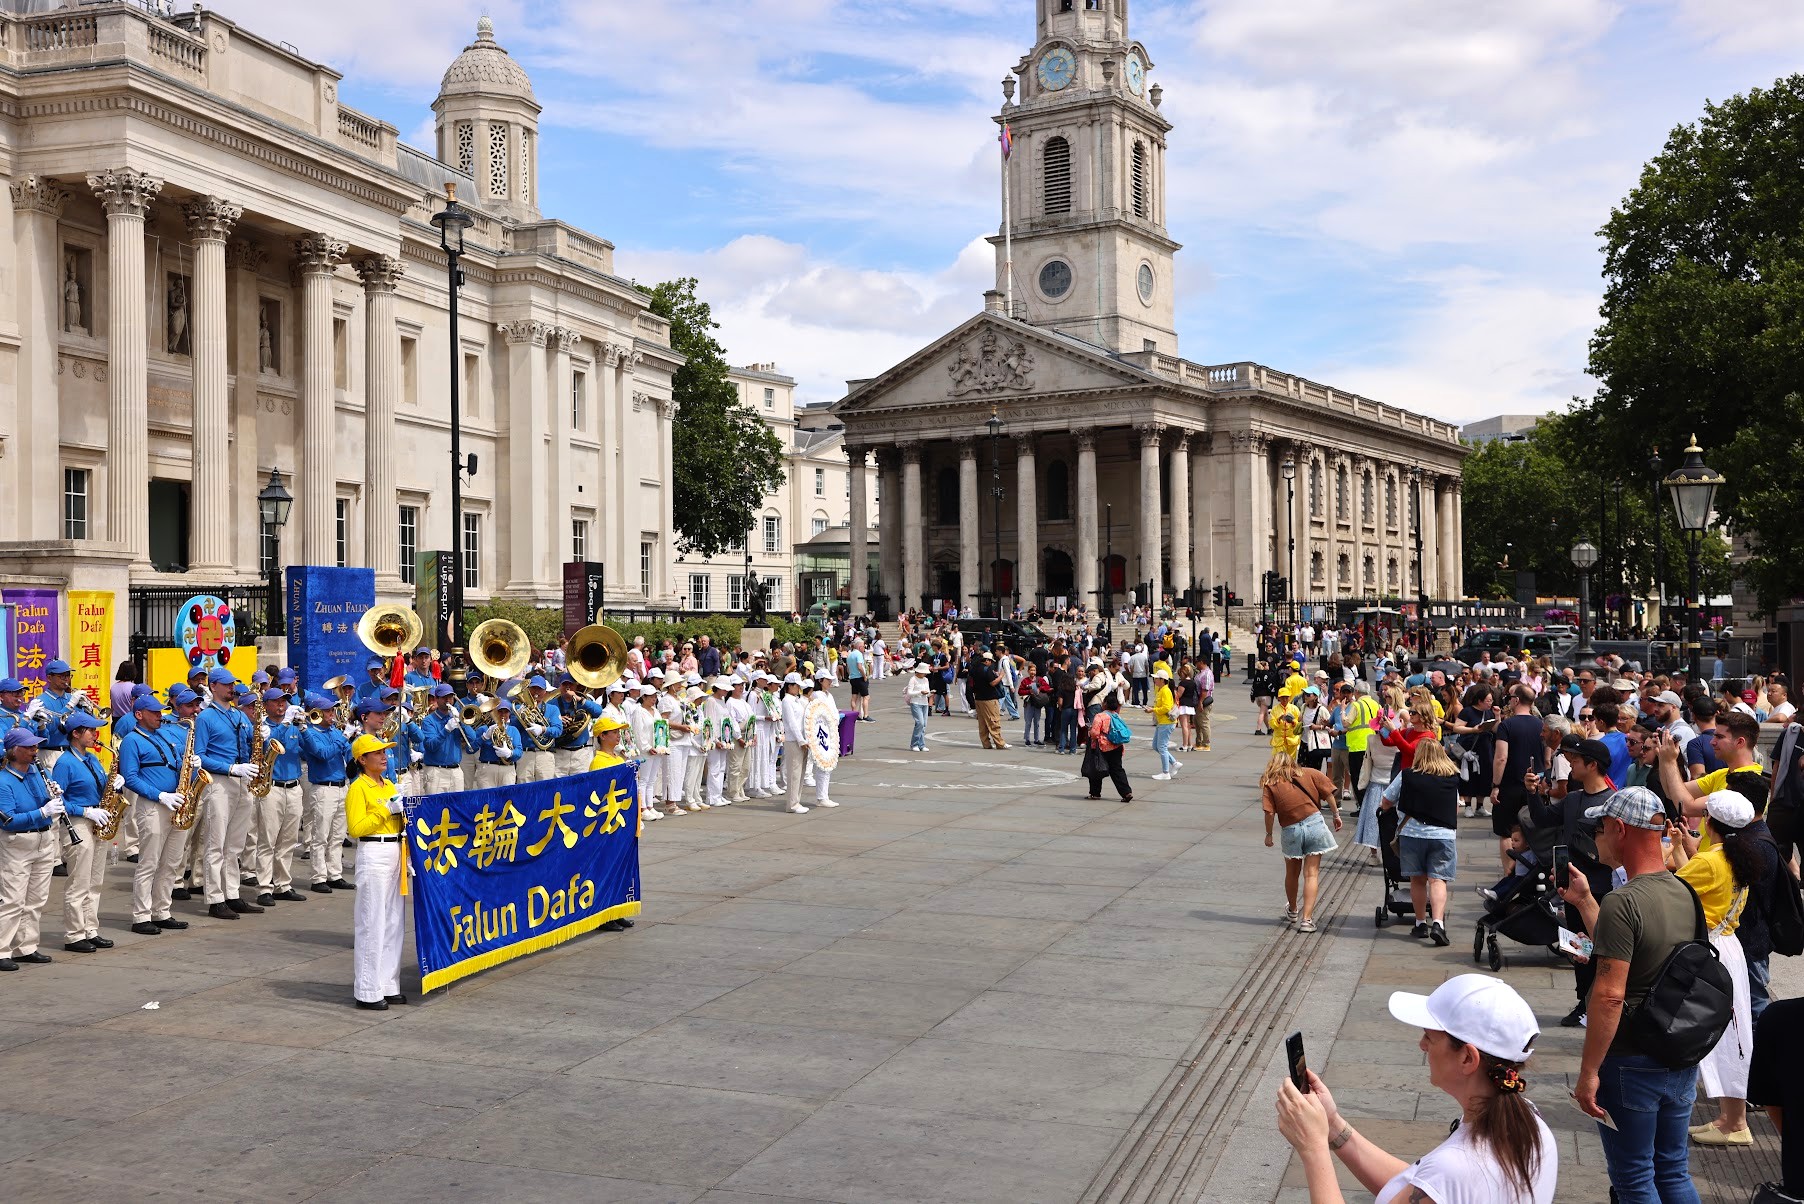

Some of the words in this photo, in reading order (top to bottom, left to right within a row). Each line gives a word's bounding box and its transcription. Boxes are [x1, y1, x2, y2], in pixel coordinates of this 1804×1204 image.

[293, 579, 303, 611] ZHUAN
[440, 565, 448, 621] Zurbarán
[16, 604, 49, 618] Falun
[77, 603, 105, 616] Falun
[314, 601, 342, 614] ZHUAN
[345, 601, 370, 613] FALUN
[17, 620, 46, 635] Dafa
[80, 620, 103, 633] Dafa
[293, 616, 303, 645] FALUN
[78, 642, 102, 669] 真
[416, 778, 633, 876] 法輪大法
[450, 900, 518, 953] Falun
[526, 873, 595, 929] Dafa
